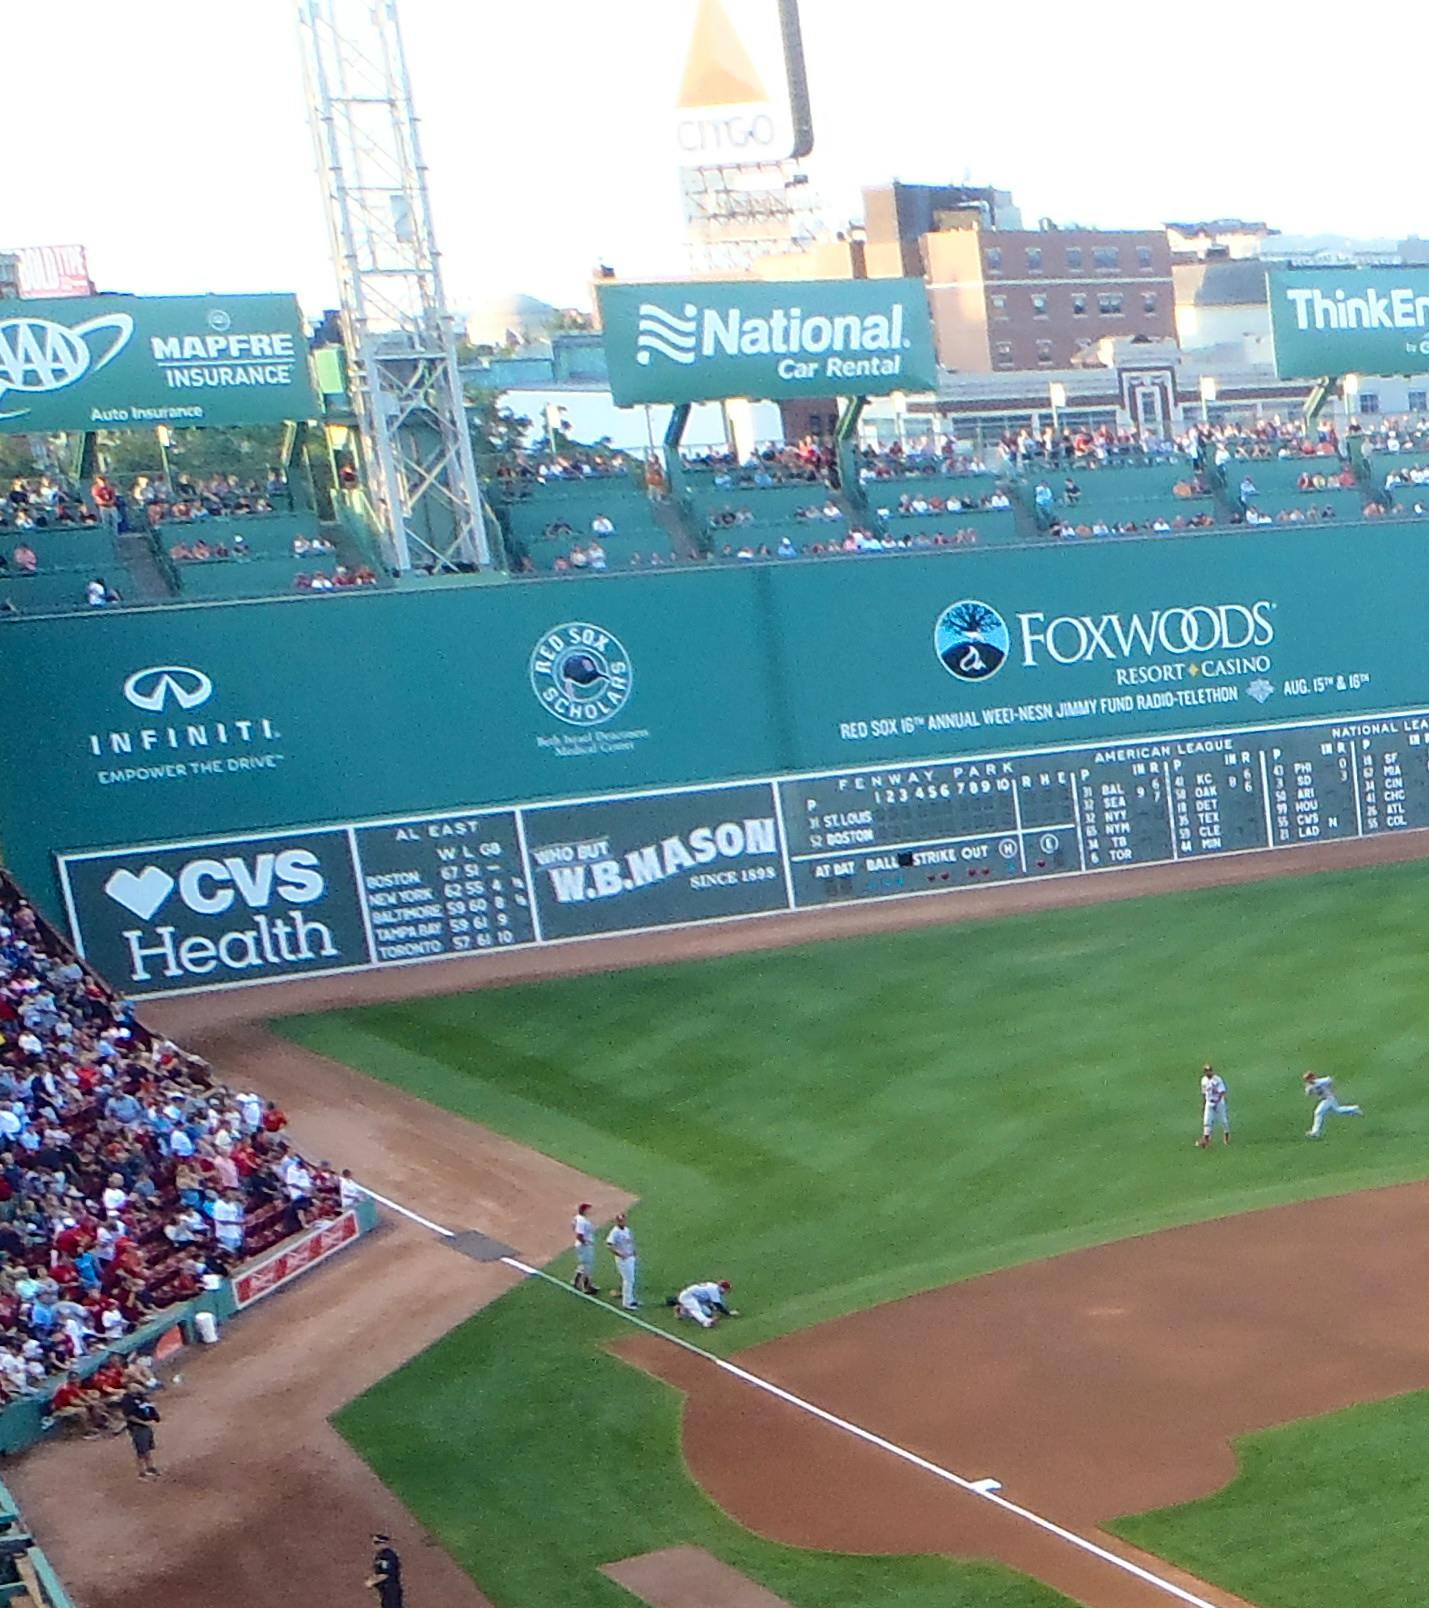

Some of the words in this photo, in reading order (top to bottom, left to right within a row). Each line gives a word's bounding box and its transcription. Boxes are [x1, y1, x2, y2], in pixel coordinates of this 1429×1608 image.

[677, 114, 775, 152] CITGO
[151, 335, 294, 360] MAPFRE
[166, 365, 291, 388] INSURANCE
[777, 358, 818, 380] Car
[826, 355, 899, 378] Rental
[92, 406, 127, 422] Auto
[132, 405, 203, 421] Insurance
[1018, 600, 1274, 667] FOXWOODS
[535, 635, 565, 673] RED
[568, 627, 609, 652] SOX
[1116, 663, 1184, 686] RESORT
[1201, 655, 1271, 678] CASINO
[542, 661, 627, 720] SCHOLARS
[840, 721, 868, 740] RED
[871, 718, 898, 737] SOX
[927, 711, 980, 731] ANNUAL
[982, 703, 1053, 726] WEEI-NESN
[1056, 699, 1097, 718] JIMMY
[1100, 695, 1134, 714] FUND
[1137, 686, 1238, 711] RADIO-TELETHON
[1283, 680, 1311, 697] AUG.
[1336, 676, 1347, 690] &
[90, 719, 273, 755] INFINITI
[1332, 722, 1399, 739] NATIONAL
[1094, 746, 1171, 764] AMERICAN
[1177, 739, 1233, 755] LEAGUE
[1384, 752, 1399, 765] SF
[98, 763, 187, 785] EMPOWER
[190, 760, 224, 774] THE
[838, 770, 933, 791] FENWAY
[953, 762, 1013, 779] PARK
[1294, 762, 1313, 775] PHI
[997, 779, 1010, 791] 10
[1196, 773, 1214, 786] KC
[1385, 777, 1403, 790] CIN
[1102, 784, 1125, 797] BAL
[1195, 786, 1218, 799] OAK
[1297, 788, 1315, 800] ARI
[1384, 789, 1405, 801] CHC
[1103, 797, 1126, 809] SEA
[1196, 800, 1218, 812] DET
[1296, 801, 1318, 813] HOU
[1386, 802, 1405, 815] ATL
[1104, 810, 1127, 823] NYY
[1197, 812, 1220, 825] TEX
[1387, 815, 1407, 827] COL
[396, 828, 421, 842] AL
[428, 821, 479, 838] EAST
[826, 829, 874, 846] BOSTON
[1105, 823, 1130, 836] NYM
[1199, 825, 1221, 838] CLE
[1298, 826, 1320, 838] LAD
[1111, 836, 1127, 848] TB
[533, 846, 574, 865] WHO
[576, 841, 609, 860] BUT
[834, 862, 856, 876] BAT
[866, 857, 898, 872] BALL
[911, 849, 957, 867] STRIKE
[961, 846, 988, 860] OUT
[1109, 848, 1133, 861] TOR
[179, 849, 324, 914] CVS
[366, 871, 421, 890] BOSTON
[690, 869, 739, 889] SINCE
[741, 866, 776, 884] 1898
[369, 893, 397, 908] NEW
[399, 888, 433, 903] YORK
[372, 904, 444, 925] BALTIMORE
[376, 925, 417, 942] TAMPA
[419, 922, 442, 937] BAY
[122, 910, 339, 982] Health
[378, 940, 443, 959] TORONTO
